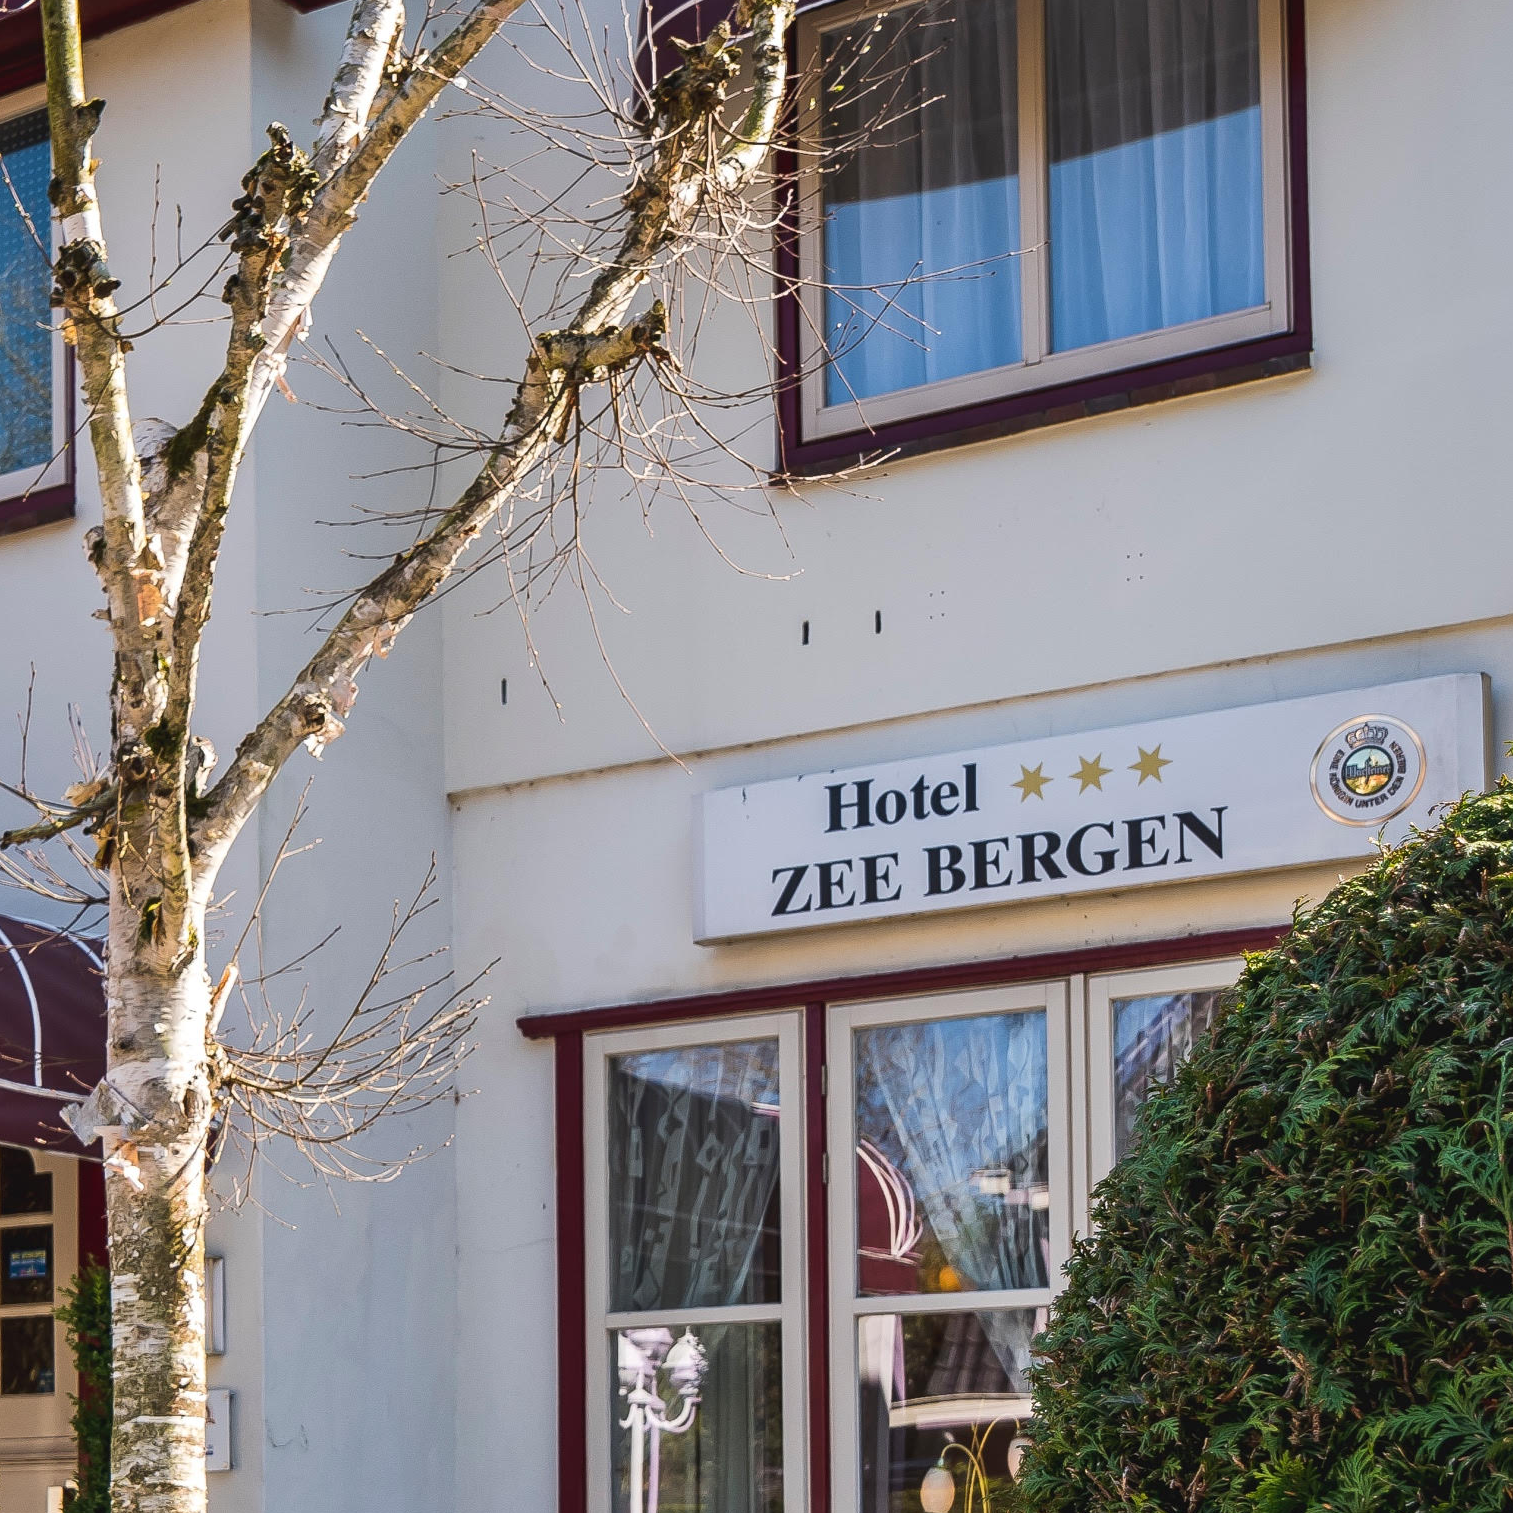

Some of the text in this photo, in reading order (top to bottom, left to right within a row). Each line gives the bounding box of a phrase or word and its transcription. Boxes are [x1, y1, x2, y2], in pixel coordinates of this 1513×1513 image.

[825, 763, 979, 833] Hotel
[1355, 793, 1389, 808] UNTER
[772, 805, 1229, 917] ZEE BERGEN
